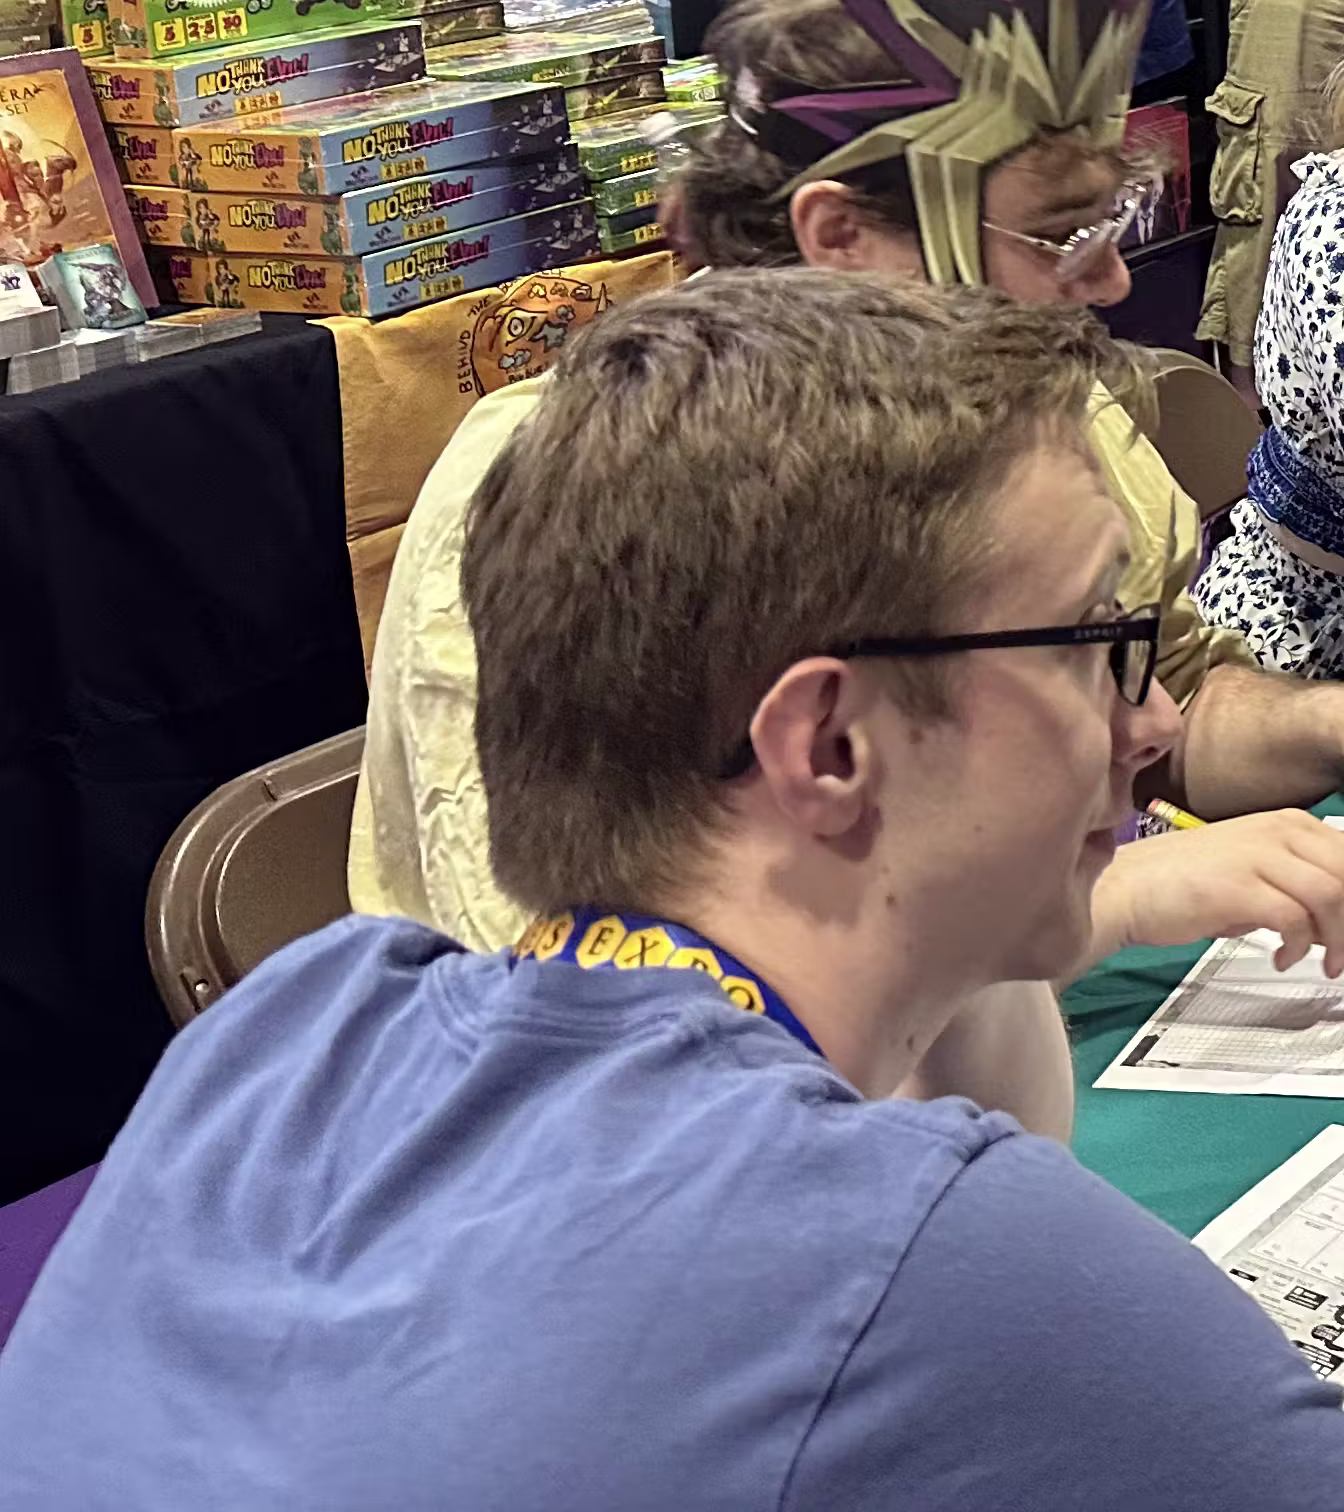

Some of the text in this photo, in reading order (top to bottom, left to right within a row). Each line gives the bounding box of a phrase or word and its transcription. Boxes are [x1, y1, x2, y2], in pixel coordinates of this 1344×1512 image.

[224, 57, 267, 78] THANK
[197, 70, 231, 98] NO
[370, 120, 412, 146] THANK
[342, 135, 376, 164] NO
[394, 181, 433, 206] THANK
[366, 198, 401, 227] NO
[411, 241, 451, 265] THANK
[383, 257, 418, 287] NO
